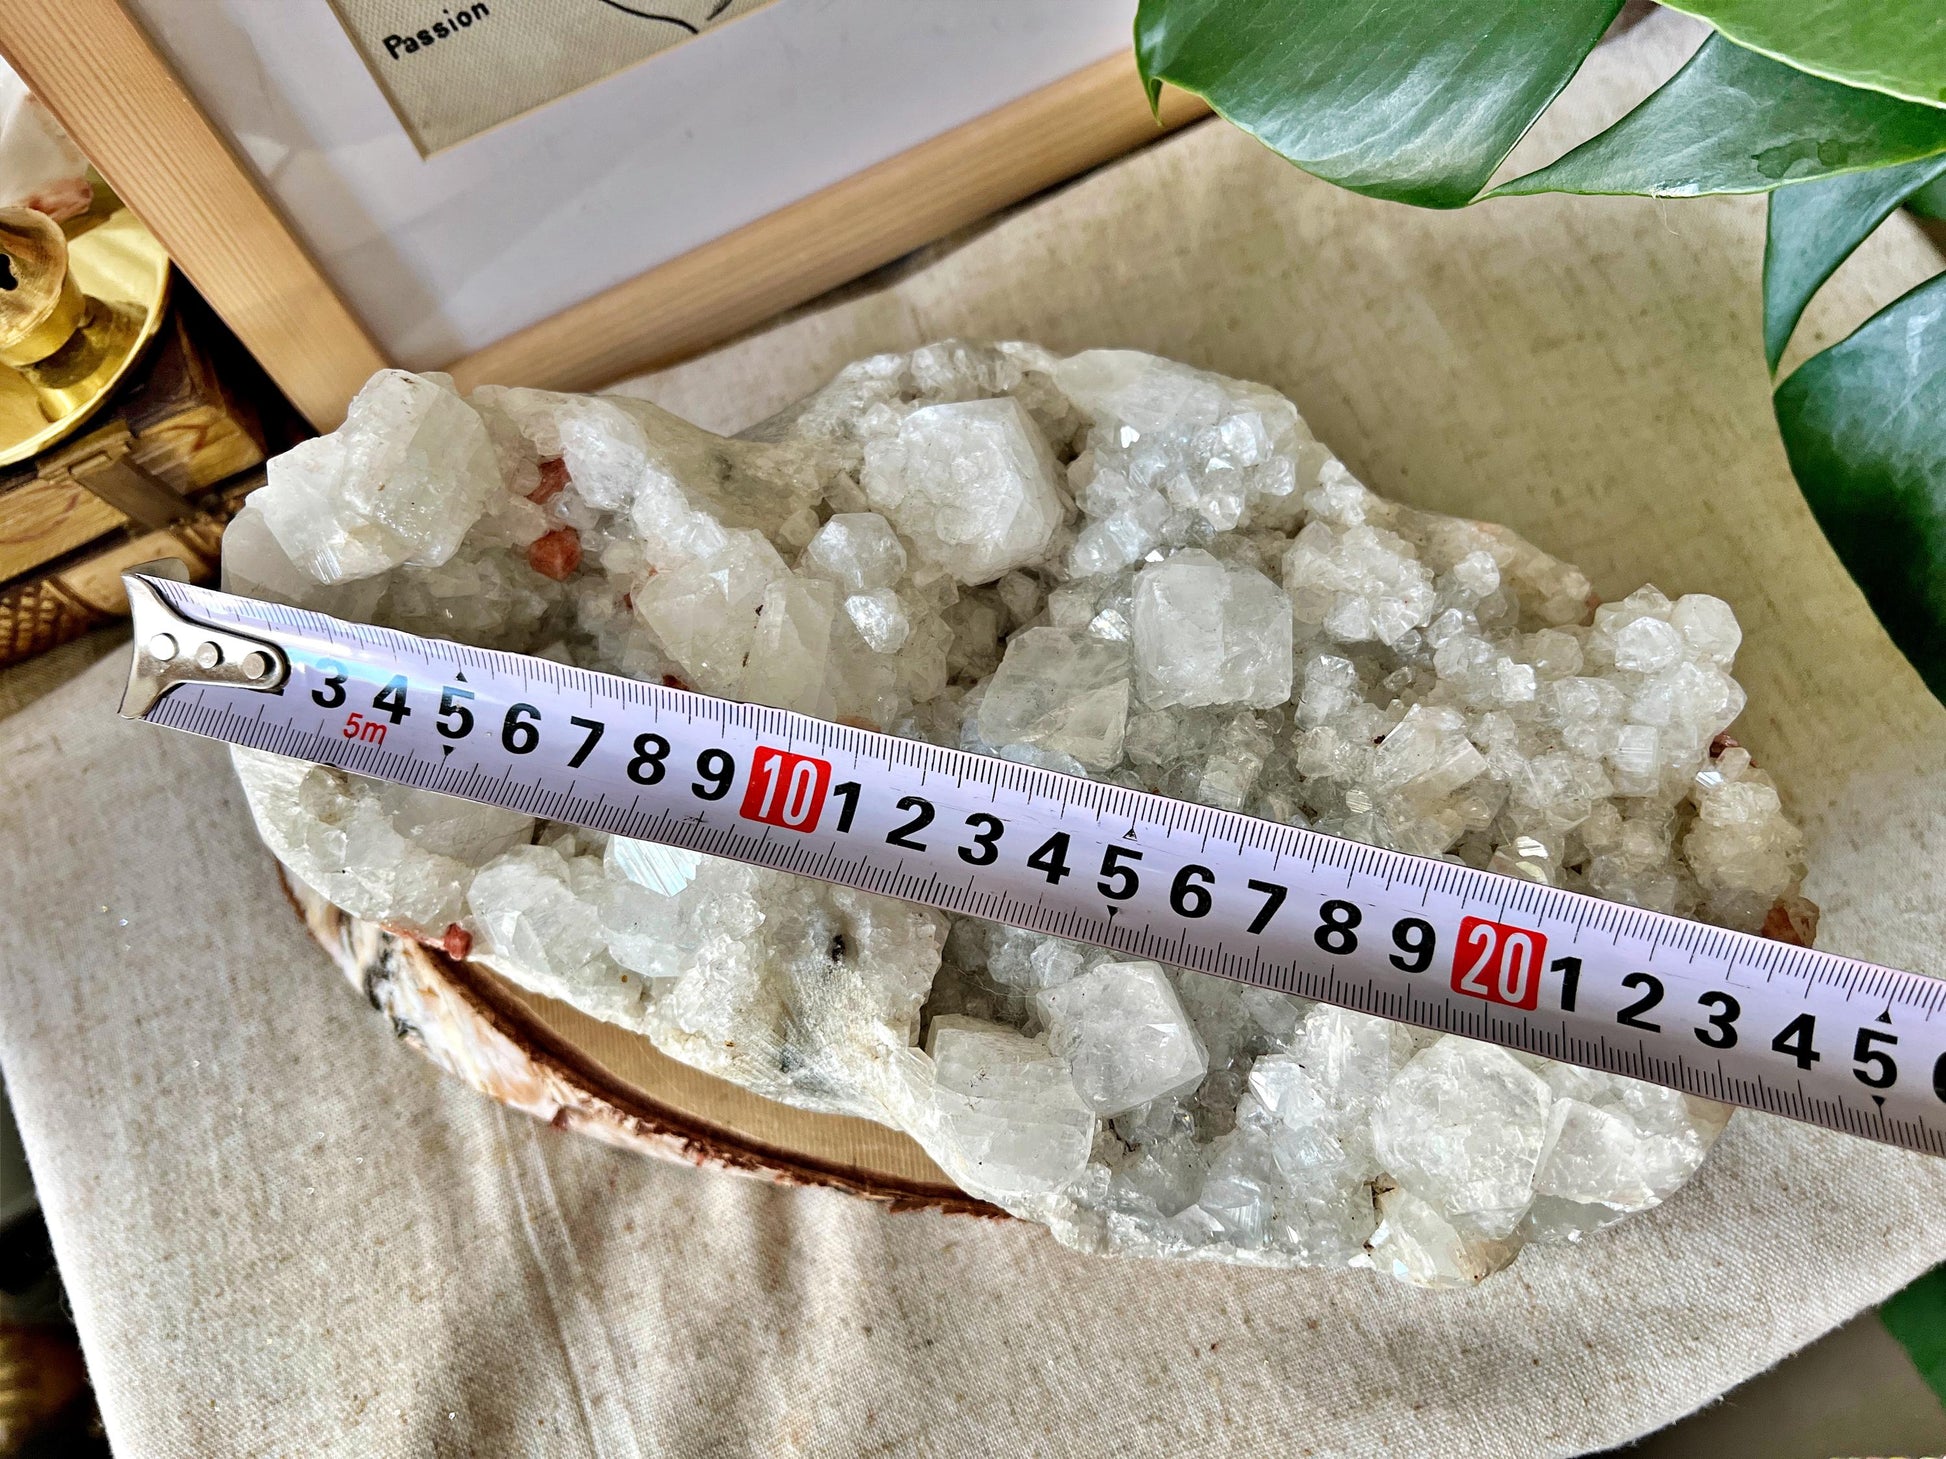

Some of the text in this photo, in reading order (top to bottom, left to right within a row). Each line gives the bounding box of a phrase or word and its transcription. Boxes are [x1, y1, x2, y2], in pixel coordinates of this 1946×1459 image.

[382, 1, 490, 61] Passion
[342, 711, 388, 746] 5m
[311, 657, 349, 709] 3
[372, 674, 412, 725] 4
[436, 685, 475, 740] 5
[502, 703, 541, 754] 6
[567, 716, 604, 768] 7
[627, 733, 670, 785] 8
[692, 749, 735, 801] 9
[761, 754, 820, 827] 10
[834, 782, 861, 833] 1
[885, 796, 935, 852] 2
[958, 813, 1004, 865] 3
[1027, 832, 1070, 885] 4
[1097, 844, 1143, 900] 5
[1170, 864, 1215, 918] 6
[1247, 879, 1287, 935] 7
[1314, 900, 1362, 955] 8
[1389, 918, 1436, 973] 9
[1460, 923, 1534, 1004] 20
[1551, 957, 1582, 1012] 1
[1617, 973, 1664, 1034] 2
[1694, 991, 1740, 1049] 3
[1772, 1013, 1820, 1071] 4
[1853, 1028, 1898, 1089] 5
